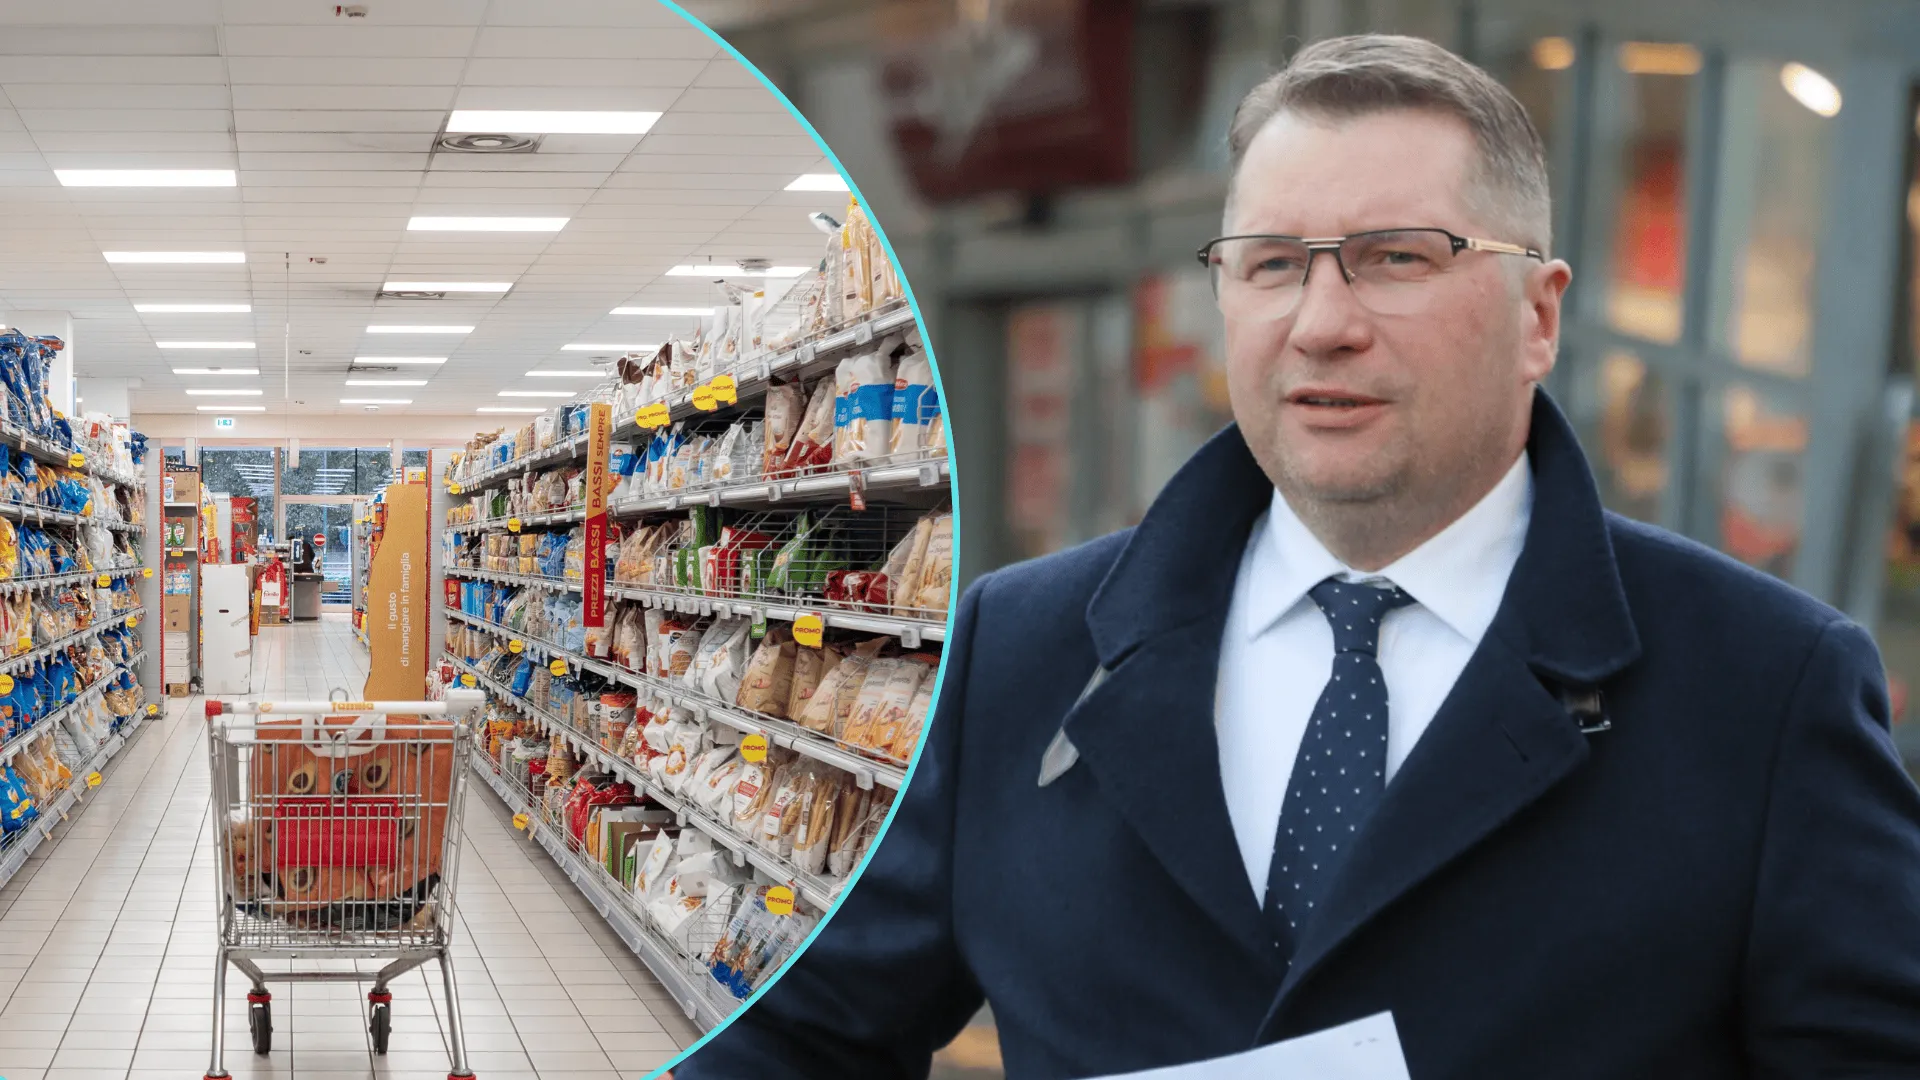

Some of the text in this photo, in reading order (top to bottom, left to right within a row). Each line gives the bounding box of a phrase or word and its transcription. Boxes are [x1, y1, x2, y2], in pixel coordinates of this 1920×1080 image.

[648, 410, 667, 418] PROMO
[590, 409, 606, 618] PREZZI BASSI BASSI SEMPRE
[389, 592, 398, 622] gusto
[401, 552, 411, 667] di mangiare in famiglia
[794, 626, 821, 634] PROMO
[742, 744, 766, 752] PROMO
[766, 896, 793, 905] PROMO
